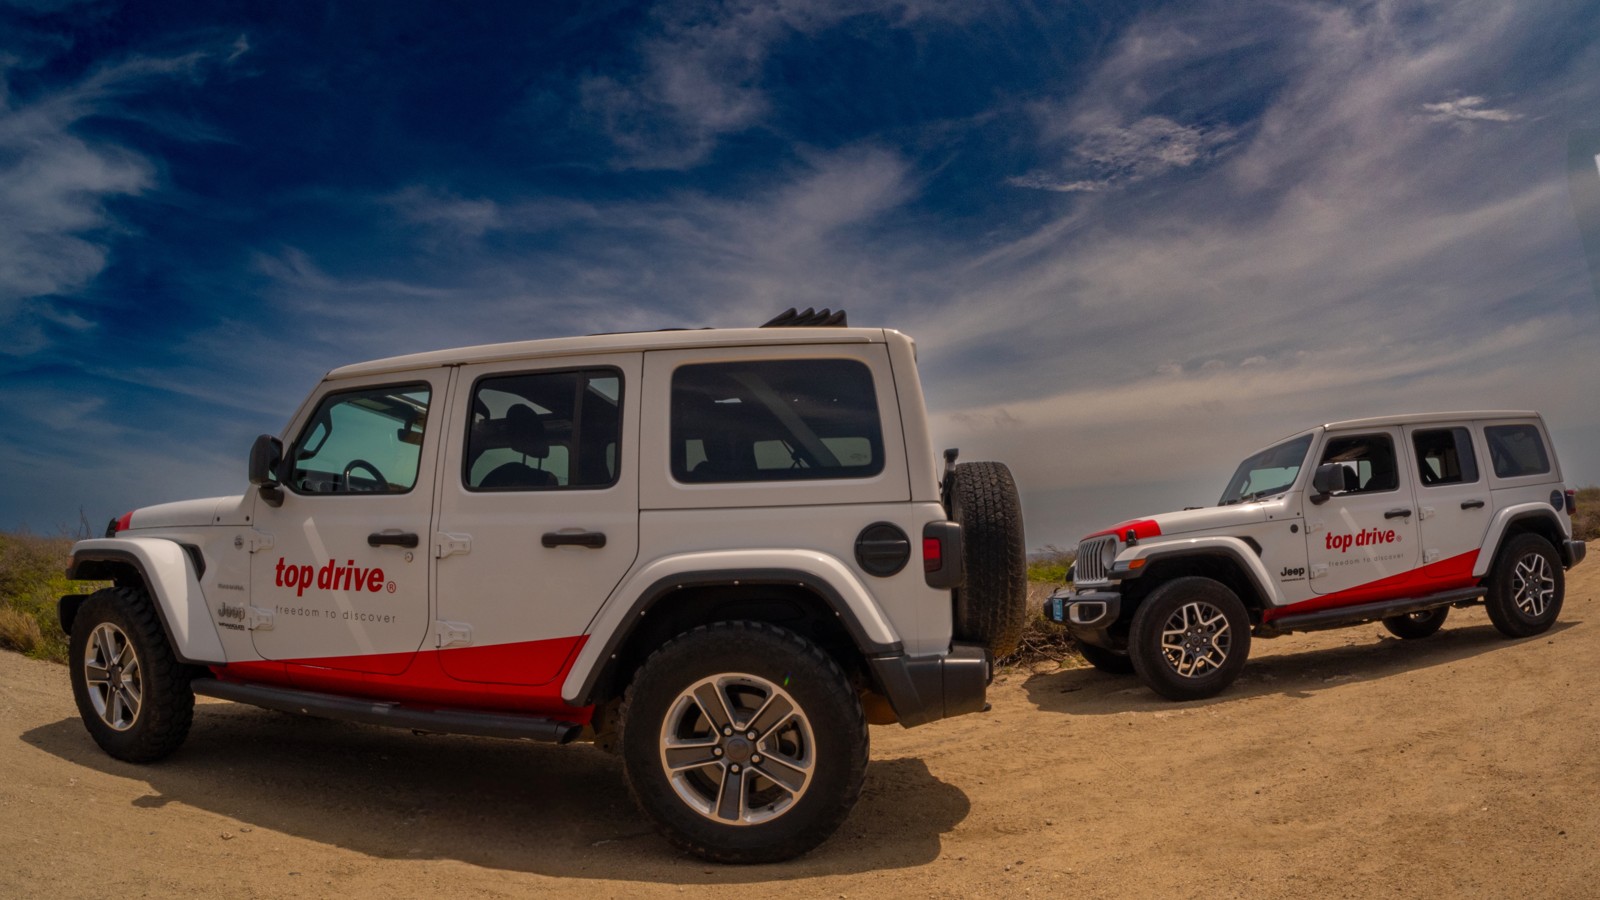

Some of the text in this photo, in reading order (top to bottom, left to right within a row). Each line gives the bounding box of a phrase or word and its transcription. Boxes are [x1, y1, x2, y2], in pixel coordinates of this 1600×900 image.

[1325, 527, 1395, 553] top drive
[1328, 558, 1360, 568] freedom
[1374, 552, 1404, 562] discover
[275, 557, 314, 597] top
[317, 559, 385, 593] drive
[1280, 566, 1305, 577] Jeep
[217, 602, 246, 623] Jeep
[275, 604, 396, 623] freedom to discover
